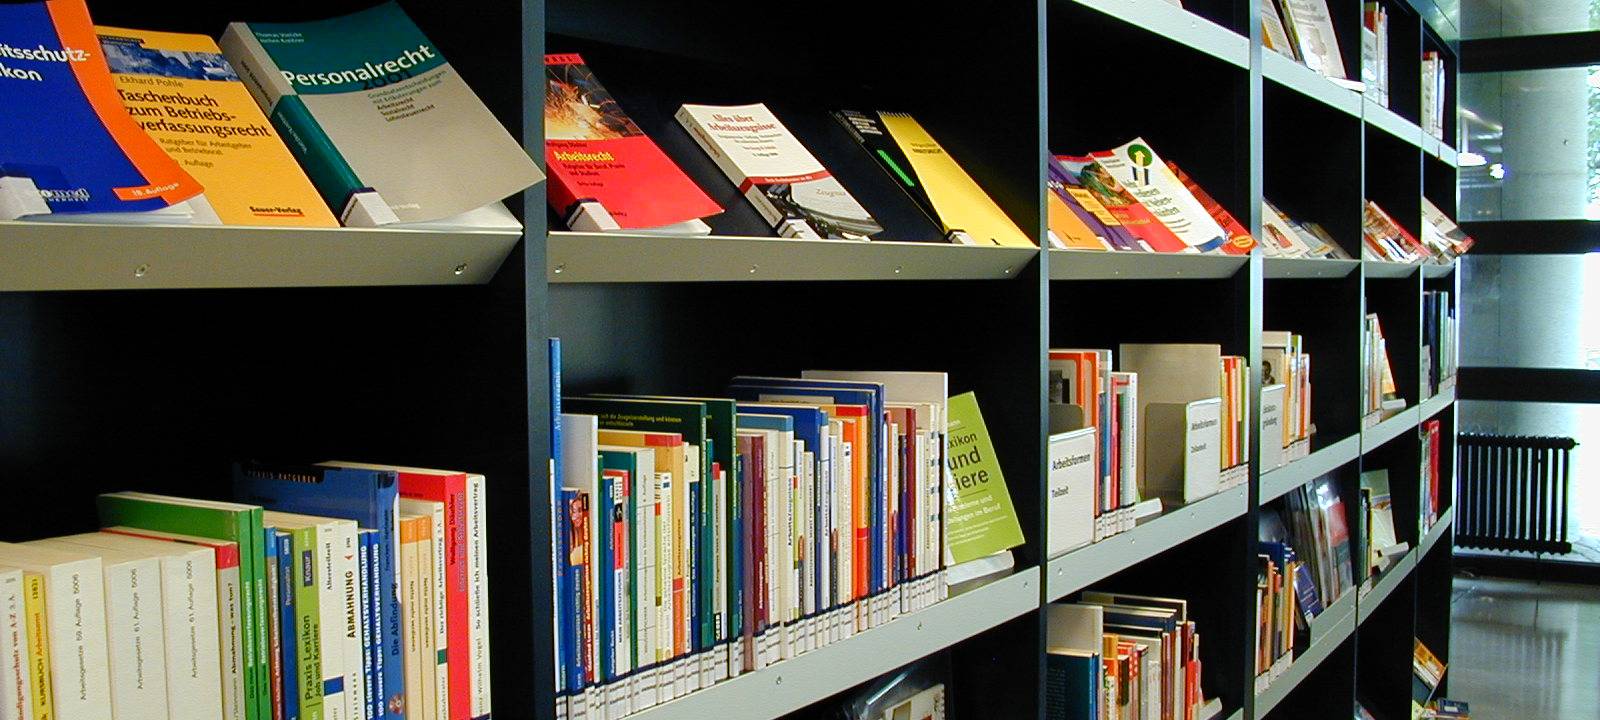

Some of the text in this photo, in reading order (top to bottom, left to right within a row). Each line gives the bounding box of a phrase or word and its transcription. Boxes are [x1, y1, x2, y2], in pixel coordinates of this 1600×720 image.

[0, 44, 91, 62] itsschutz-
[280, 44, 436, 86] Personalrecht
[0, 62, 43, 82] kon
[119, 75, 184, 88] Ekhard Pohle
[117, 88, 219, 107] Taschenbuch
[126, 105, 237, 122] zum Betriebs-
[711, 114, 754, 122] Alles über
[136, 118, 272, 139] verfassungsrecht
[707, 122, 776, 134] Arbeitszeugnisse
[553, 151, 615, 161] Arbeitsrecht
[947, 433, 978, 450] xikon
[947, 446, 981, 471] und
[1052, 454, 1091, 471] Arbeitsformen
[954, 469, 990, 491] iere
[472, 482, 480, 538] Arbeitsvertrag
[304, 555, 312, 582] Knaur
[131, 592, 139, 620] Auflage
[186, 583, 194, 610] Auflage
[345, 570, 356, 639] ABMAHNUNG
[360, 546, 370, 648] GEHALTSVERHANDLUNG
[373, 543, 382, 645] GEHALTSVERHANDLUNG
[74, 598, 82, 628] Auflage
[388, 583, 399, 656] Die Abfindung
[190, 626, 198, 678] Arbeitsgesetze
[229, 625, 237, 674] Abmahnung
[312, 623, 320, 661] Karriere
[135, 636, 143, 690] Arbeitsgesetze
[301, 615, 313, 700] Praxis Lexikon
[78, 645, 87, 701] Arbeitsgesetze
